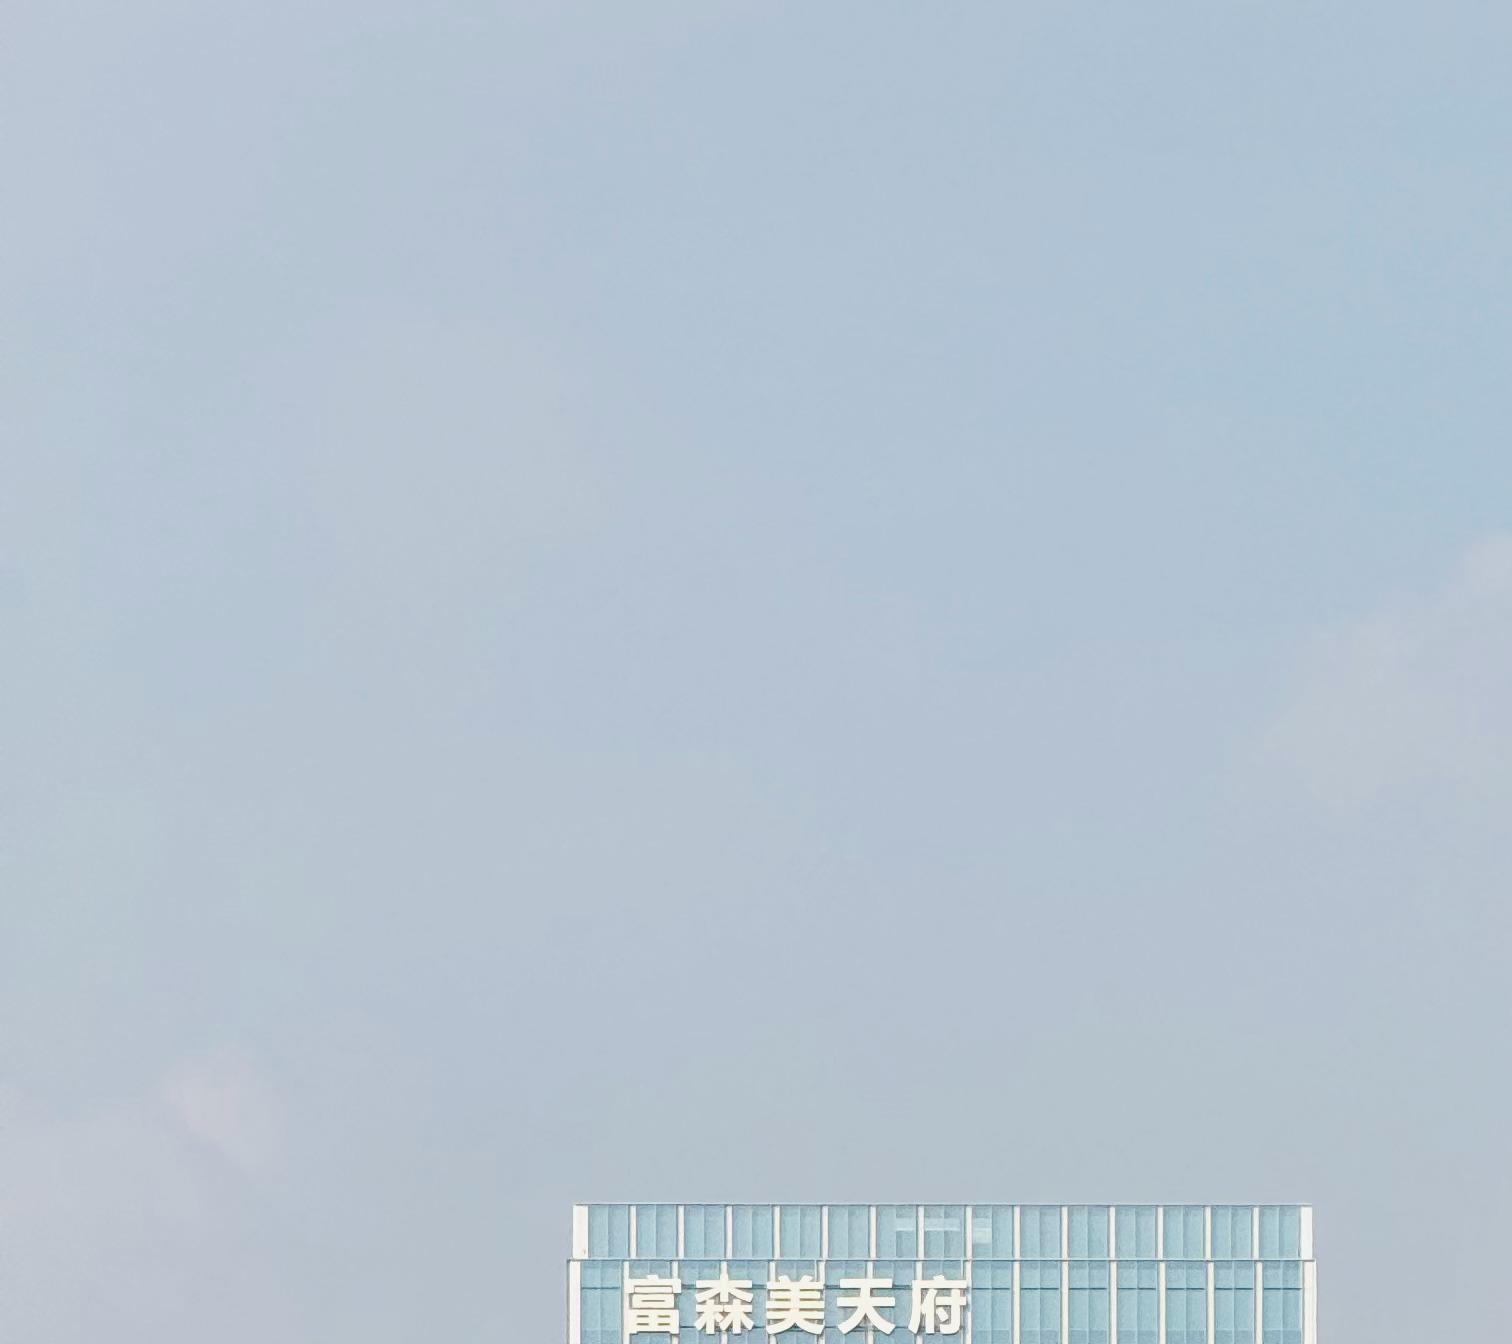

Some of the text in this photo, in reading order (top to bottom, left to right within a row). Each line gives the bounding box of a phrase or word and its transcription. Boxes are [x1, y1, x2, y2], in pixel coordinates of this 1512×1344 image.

[623, 1274, 968, 1335] 富森美天府
